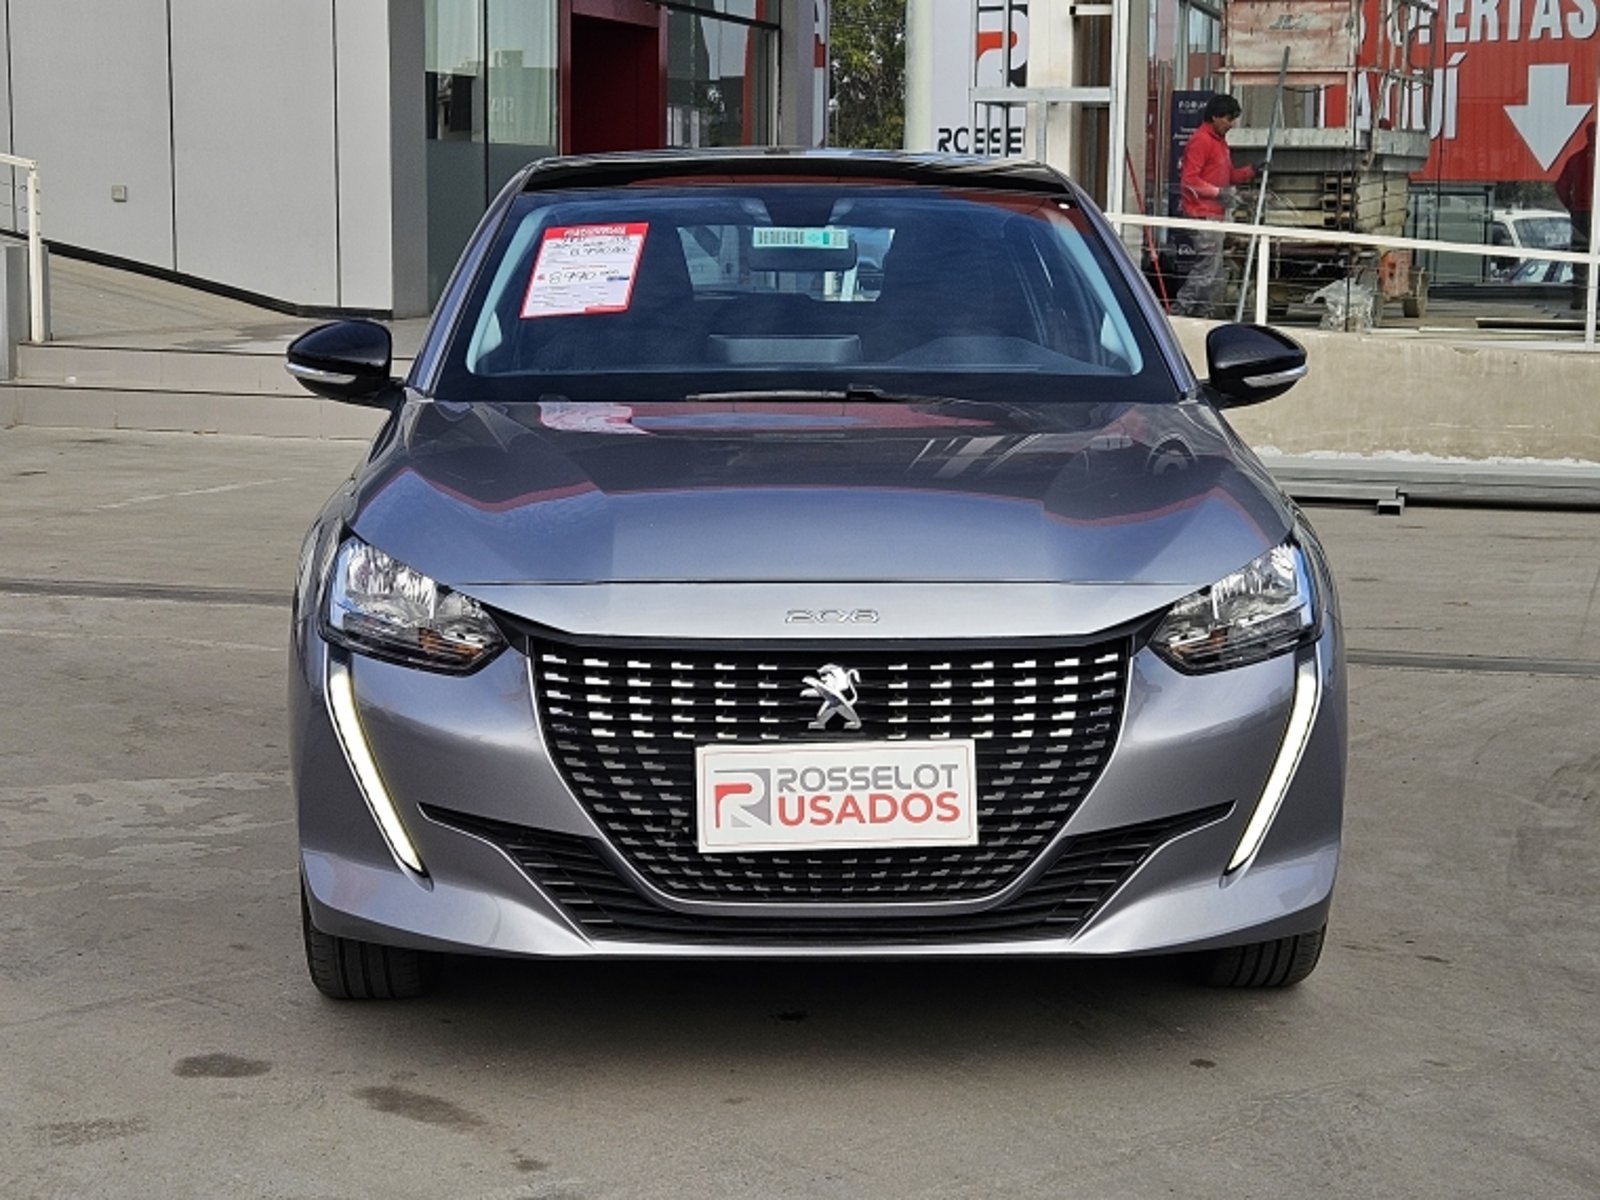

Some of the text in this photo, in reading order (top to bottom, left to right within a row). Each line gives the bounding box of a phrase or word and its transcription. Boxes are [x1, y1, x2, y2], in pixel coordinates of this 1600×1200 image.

[784, 609, 880, 624] 208
[777, 764, 958, 793] ROSSELOT
[778, 791, 961, 827] USADOS
